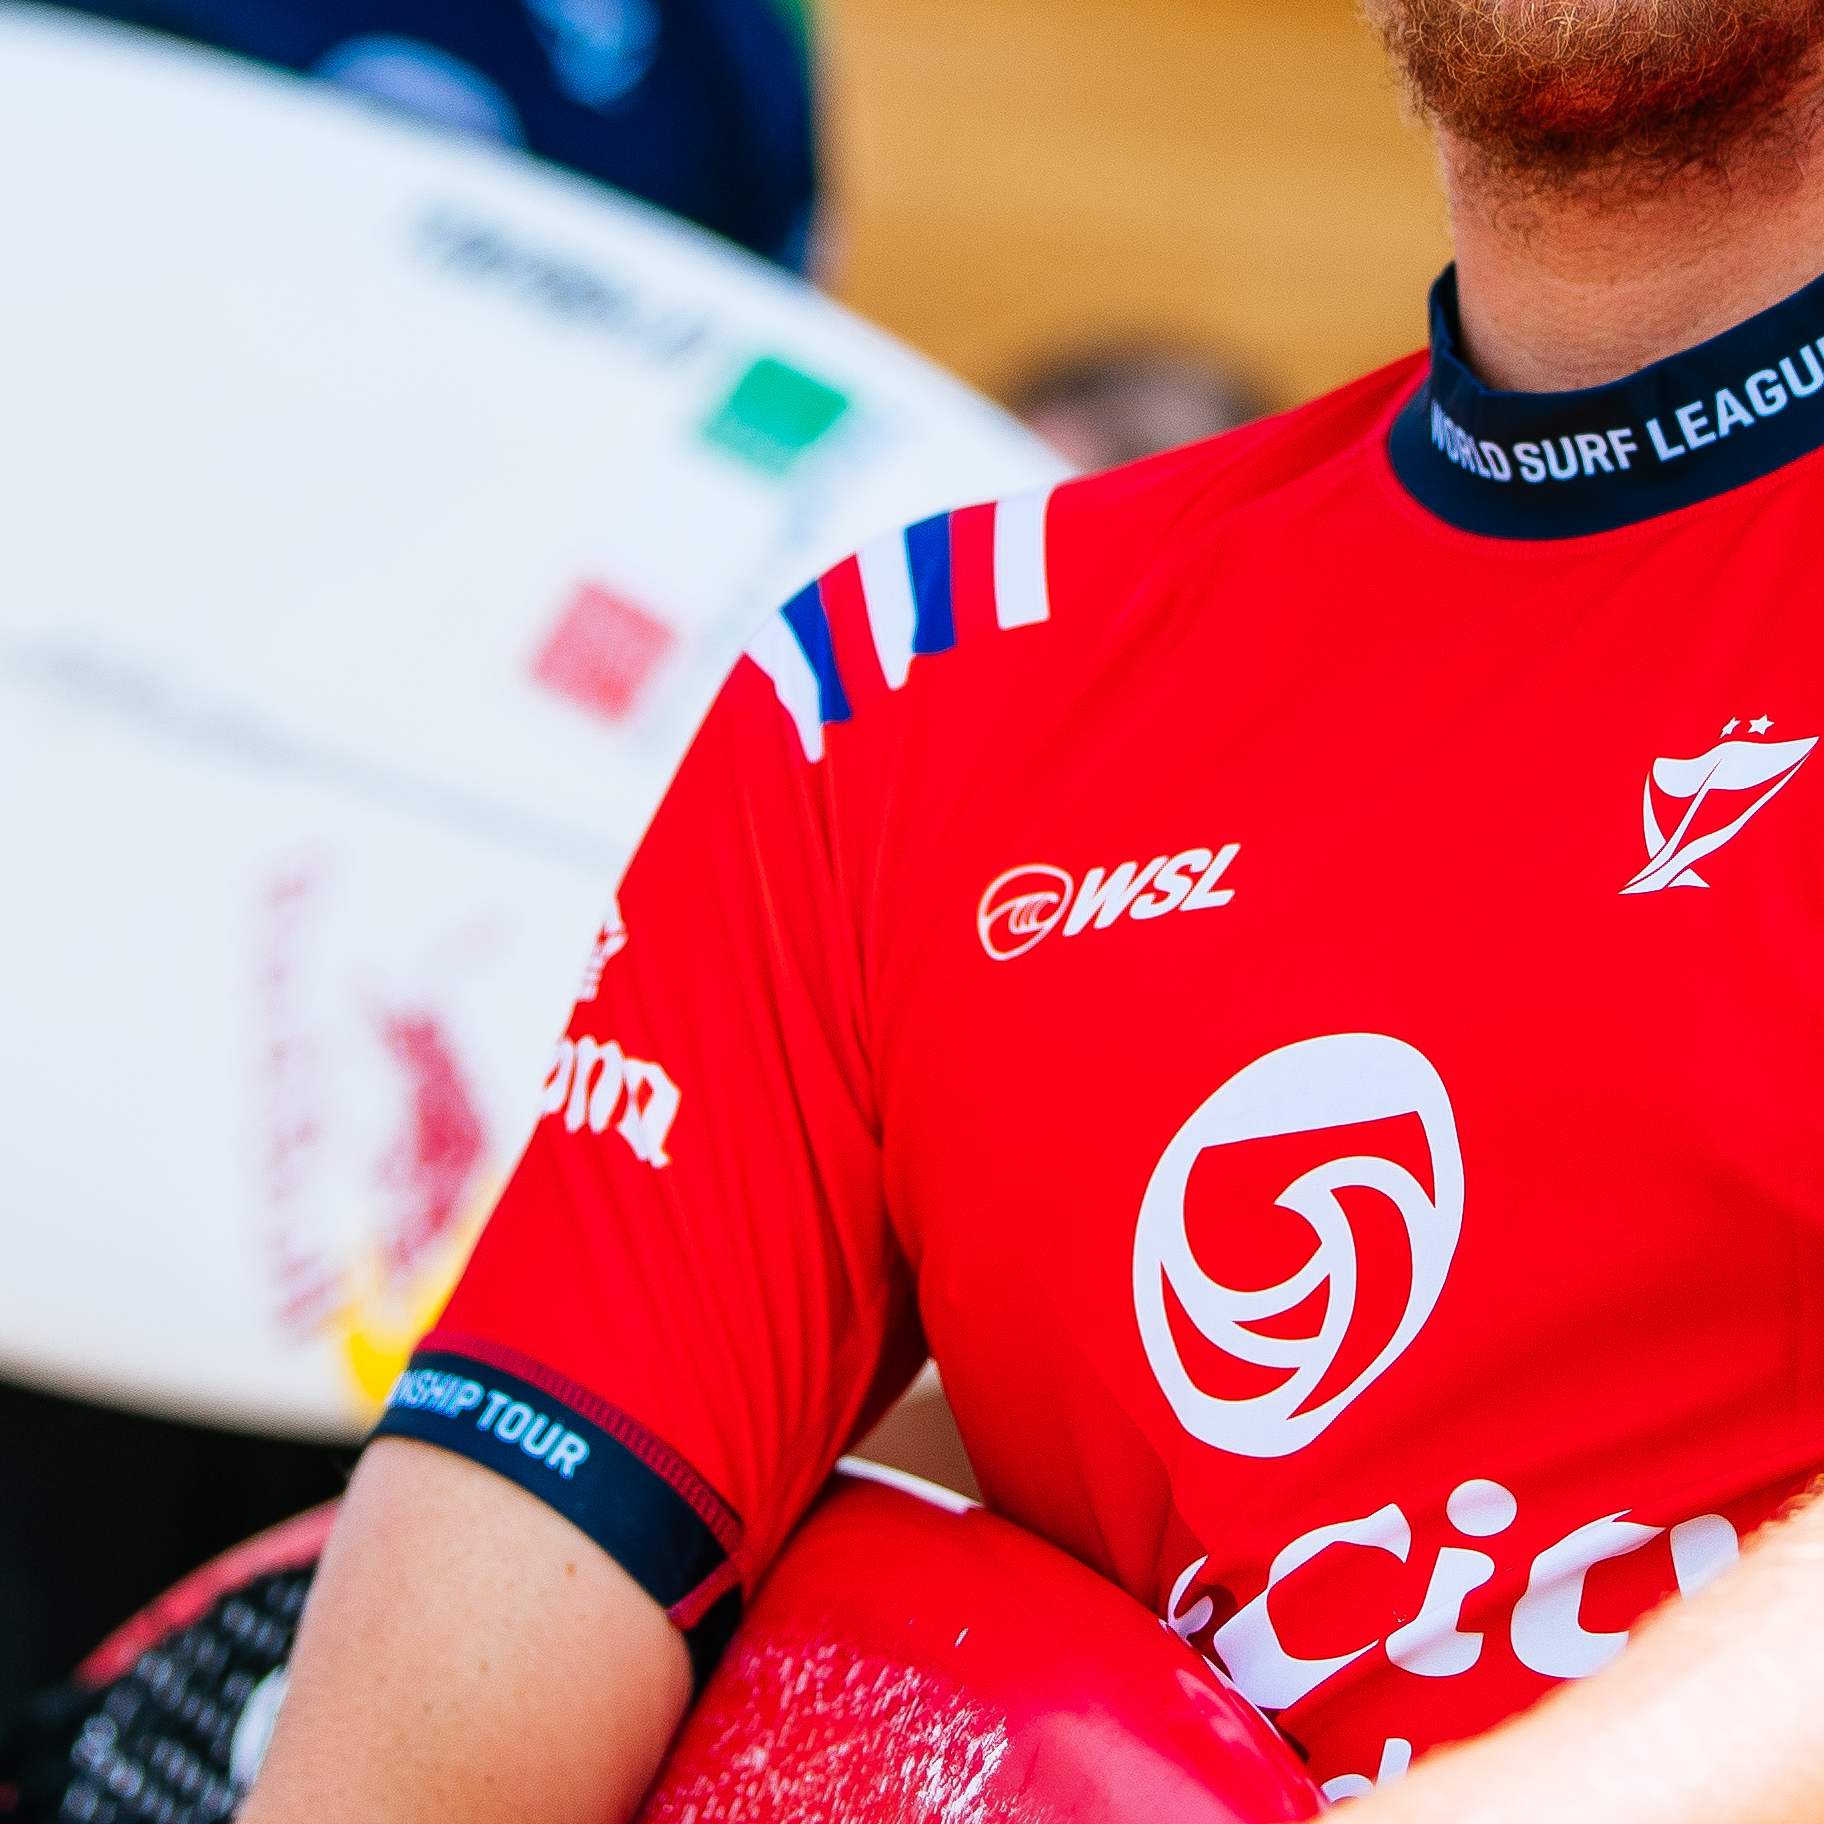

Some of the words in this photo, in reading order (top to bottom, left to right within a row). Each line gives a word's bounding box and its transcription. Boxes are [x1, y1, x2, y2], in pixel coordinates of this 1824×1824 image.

[1512, 427, 1638, 483] SURF
[1062, 843, 1241, 936] WSL
[476, 1389, 590, 1479] TOUR
